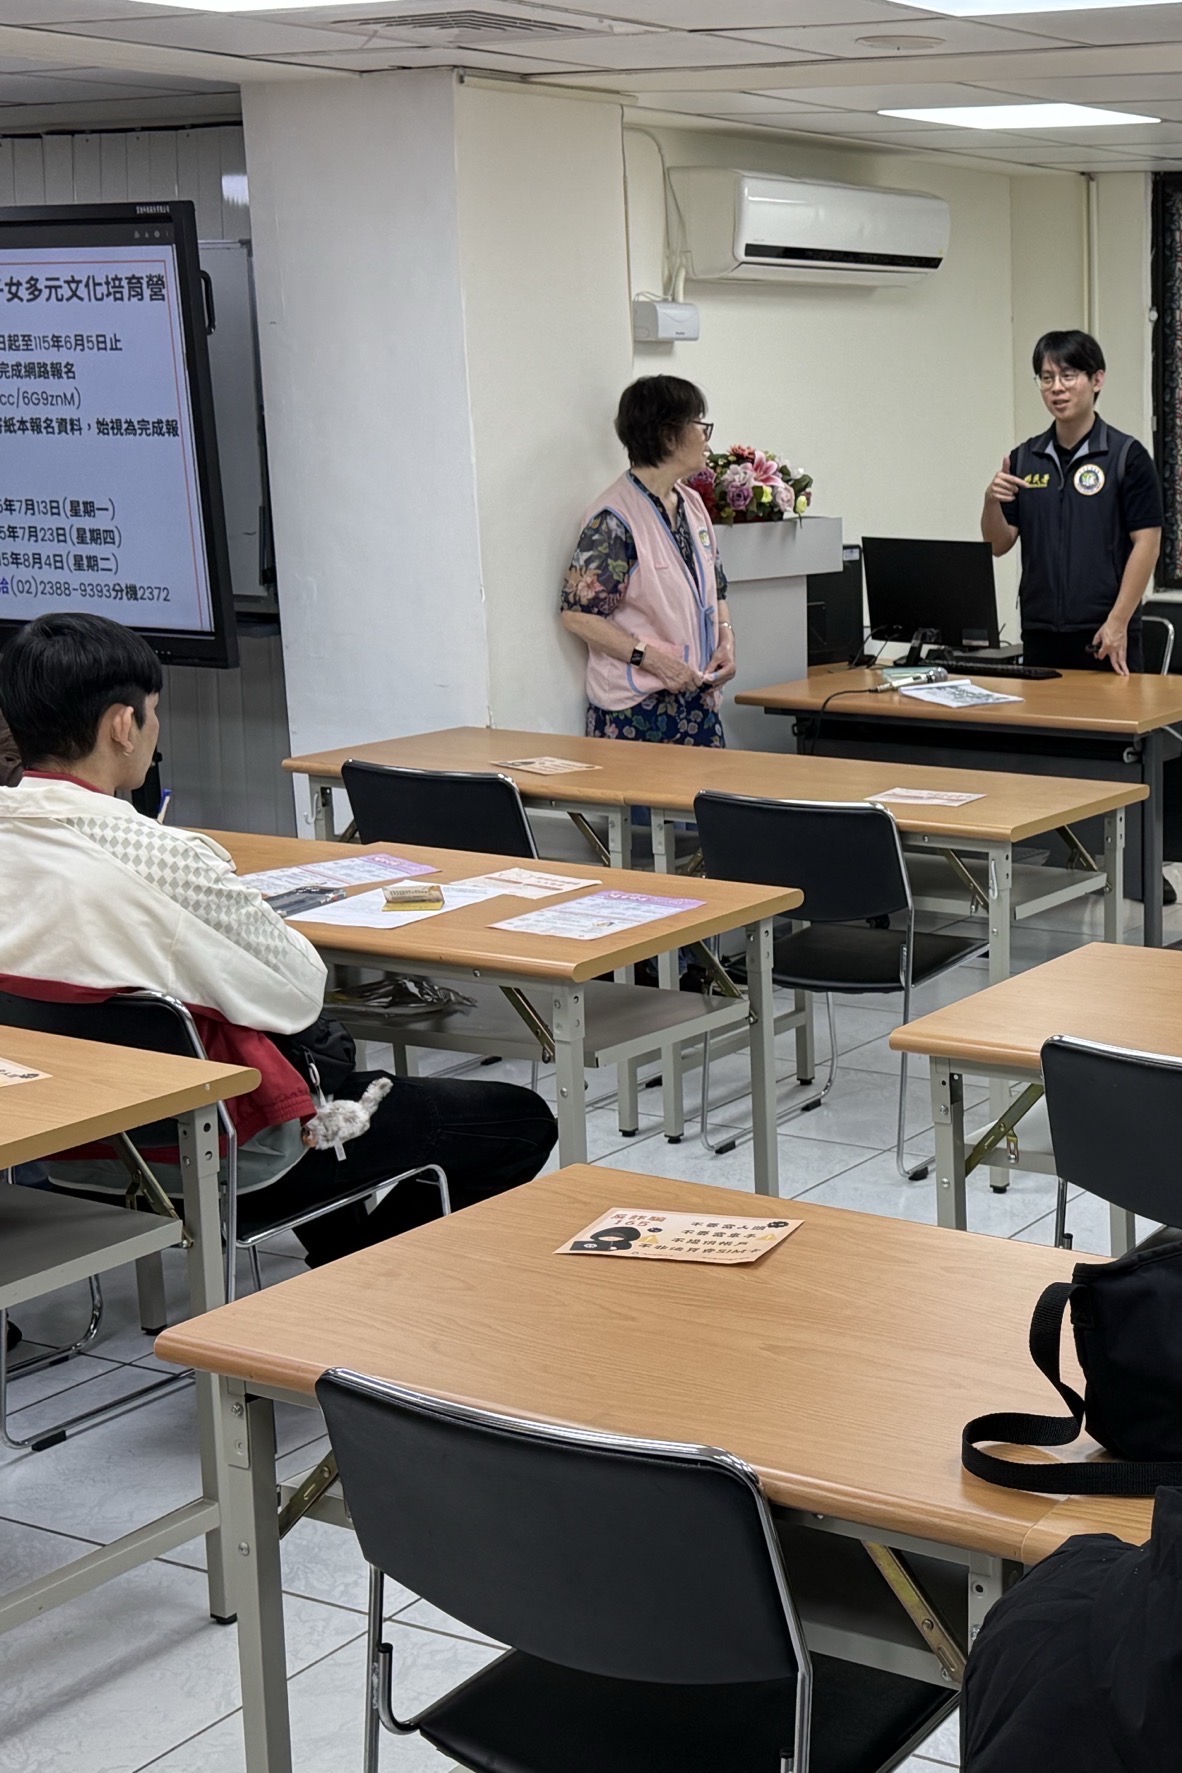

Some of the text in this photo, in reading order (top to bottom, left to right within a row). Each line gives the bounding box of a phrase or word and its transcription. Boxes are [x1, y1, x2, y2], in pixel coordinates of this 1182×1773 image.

[0, 416, 180, 438] 紙本報名資料，始視為完成報
